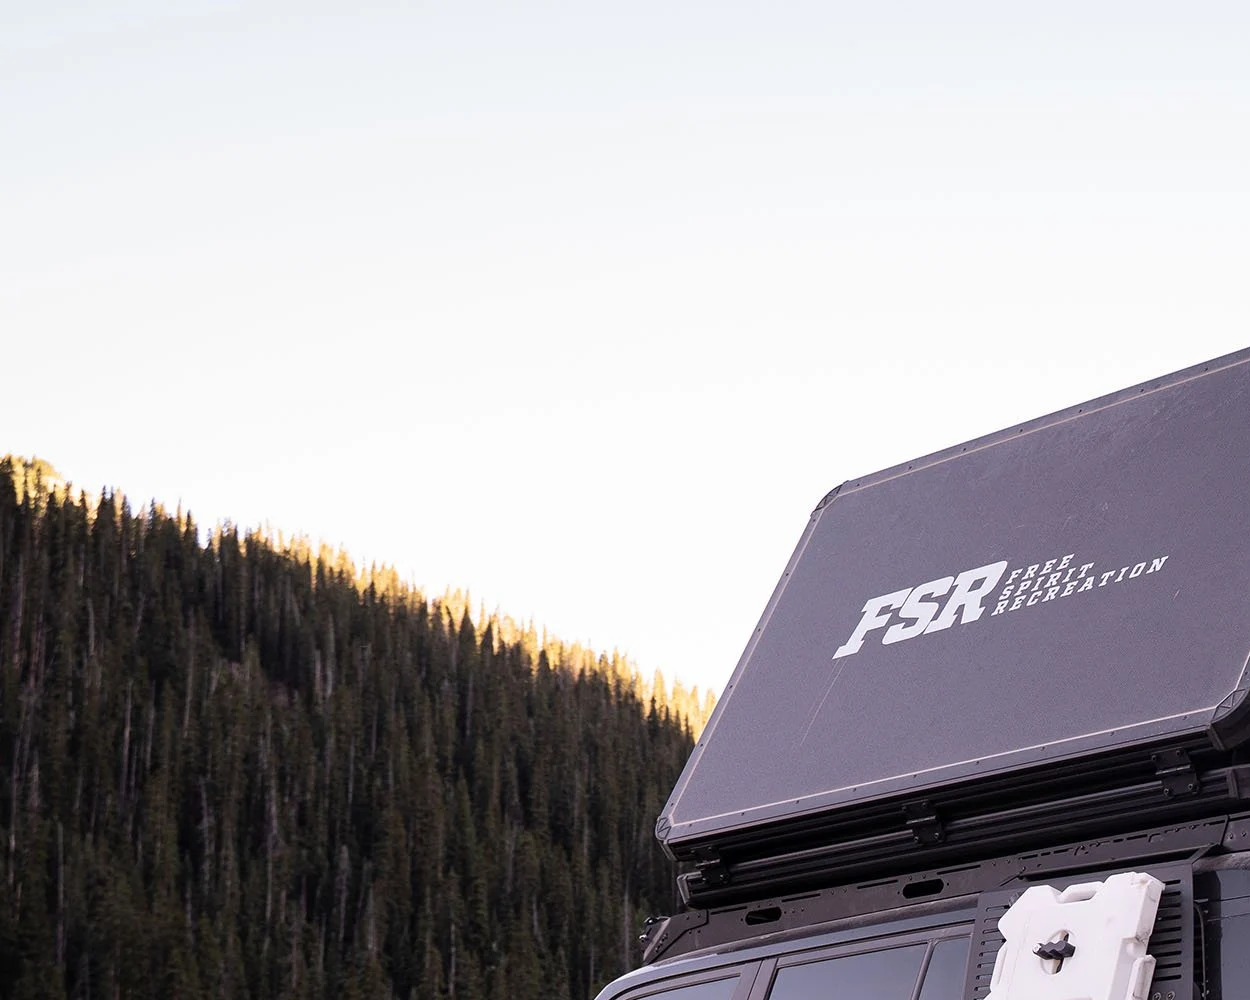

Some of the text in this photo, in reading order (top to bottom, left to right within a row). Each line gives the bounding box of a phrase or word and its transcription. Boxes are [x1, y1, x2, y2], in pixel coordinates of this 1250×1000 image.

[990, 555, 1169, 617] RECREATION
[998, 562, 1095, 601] SPIRIT
[1006, 553, 1075, 585] FREE
[832, 560, 1008, 660] FSR
